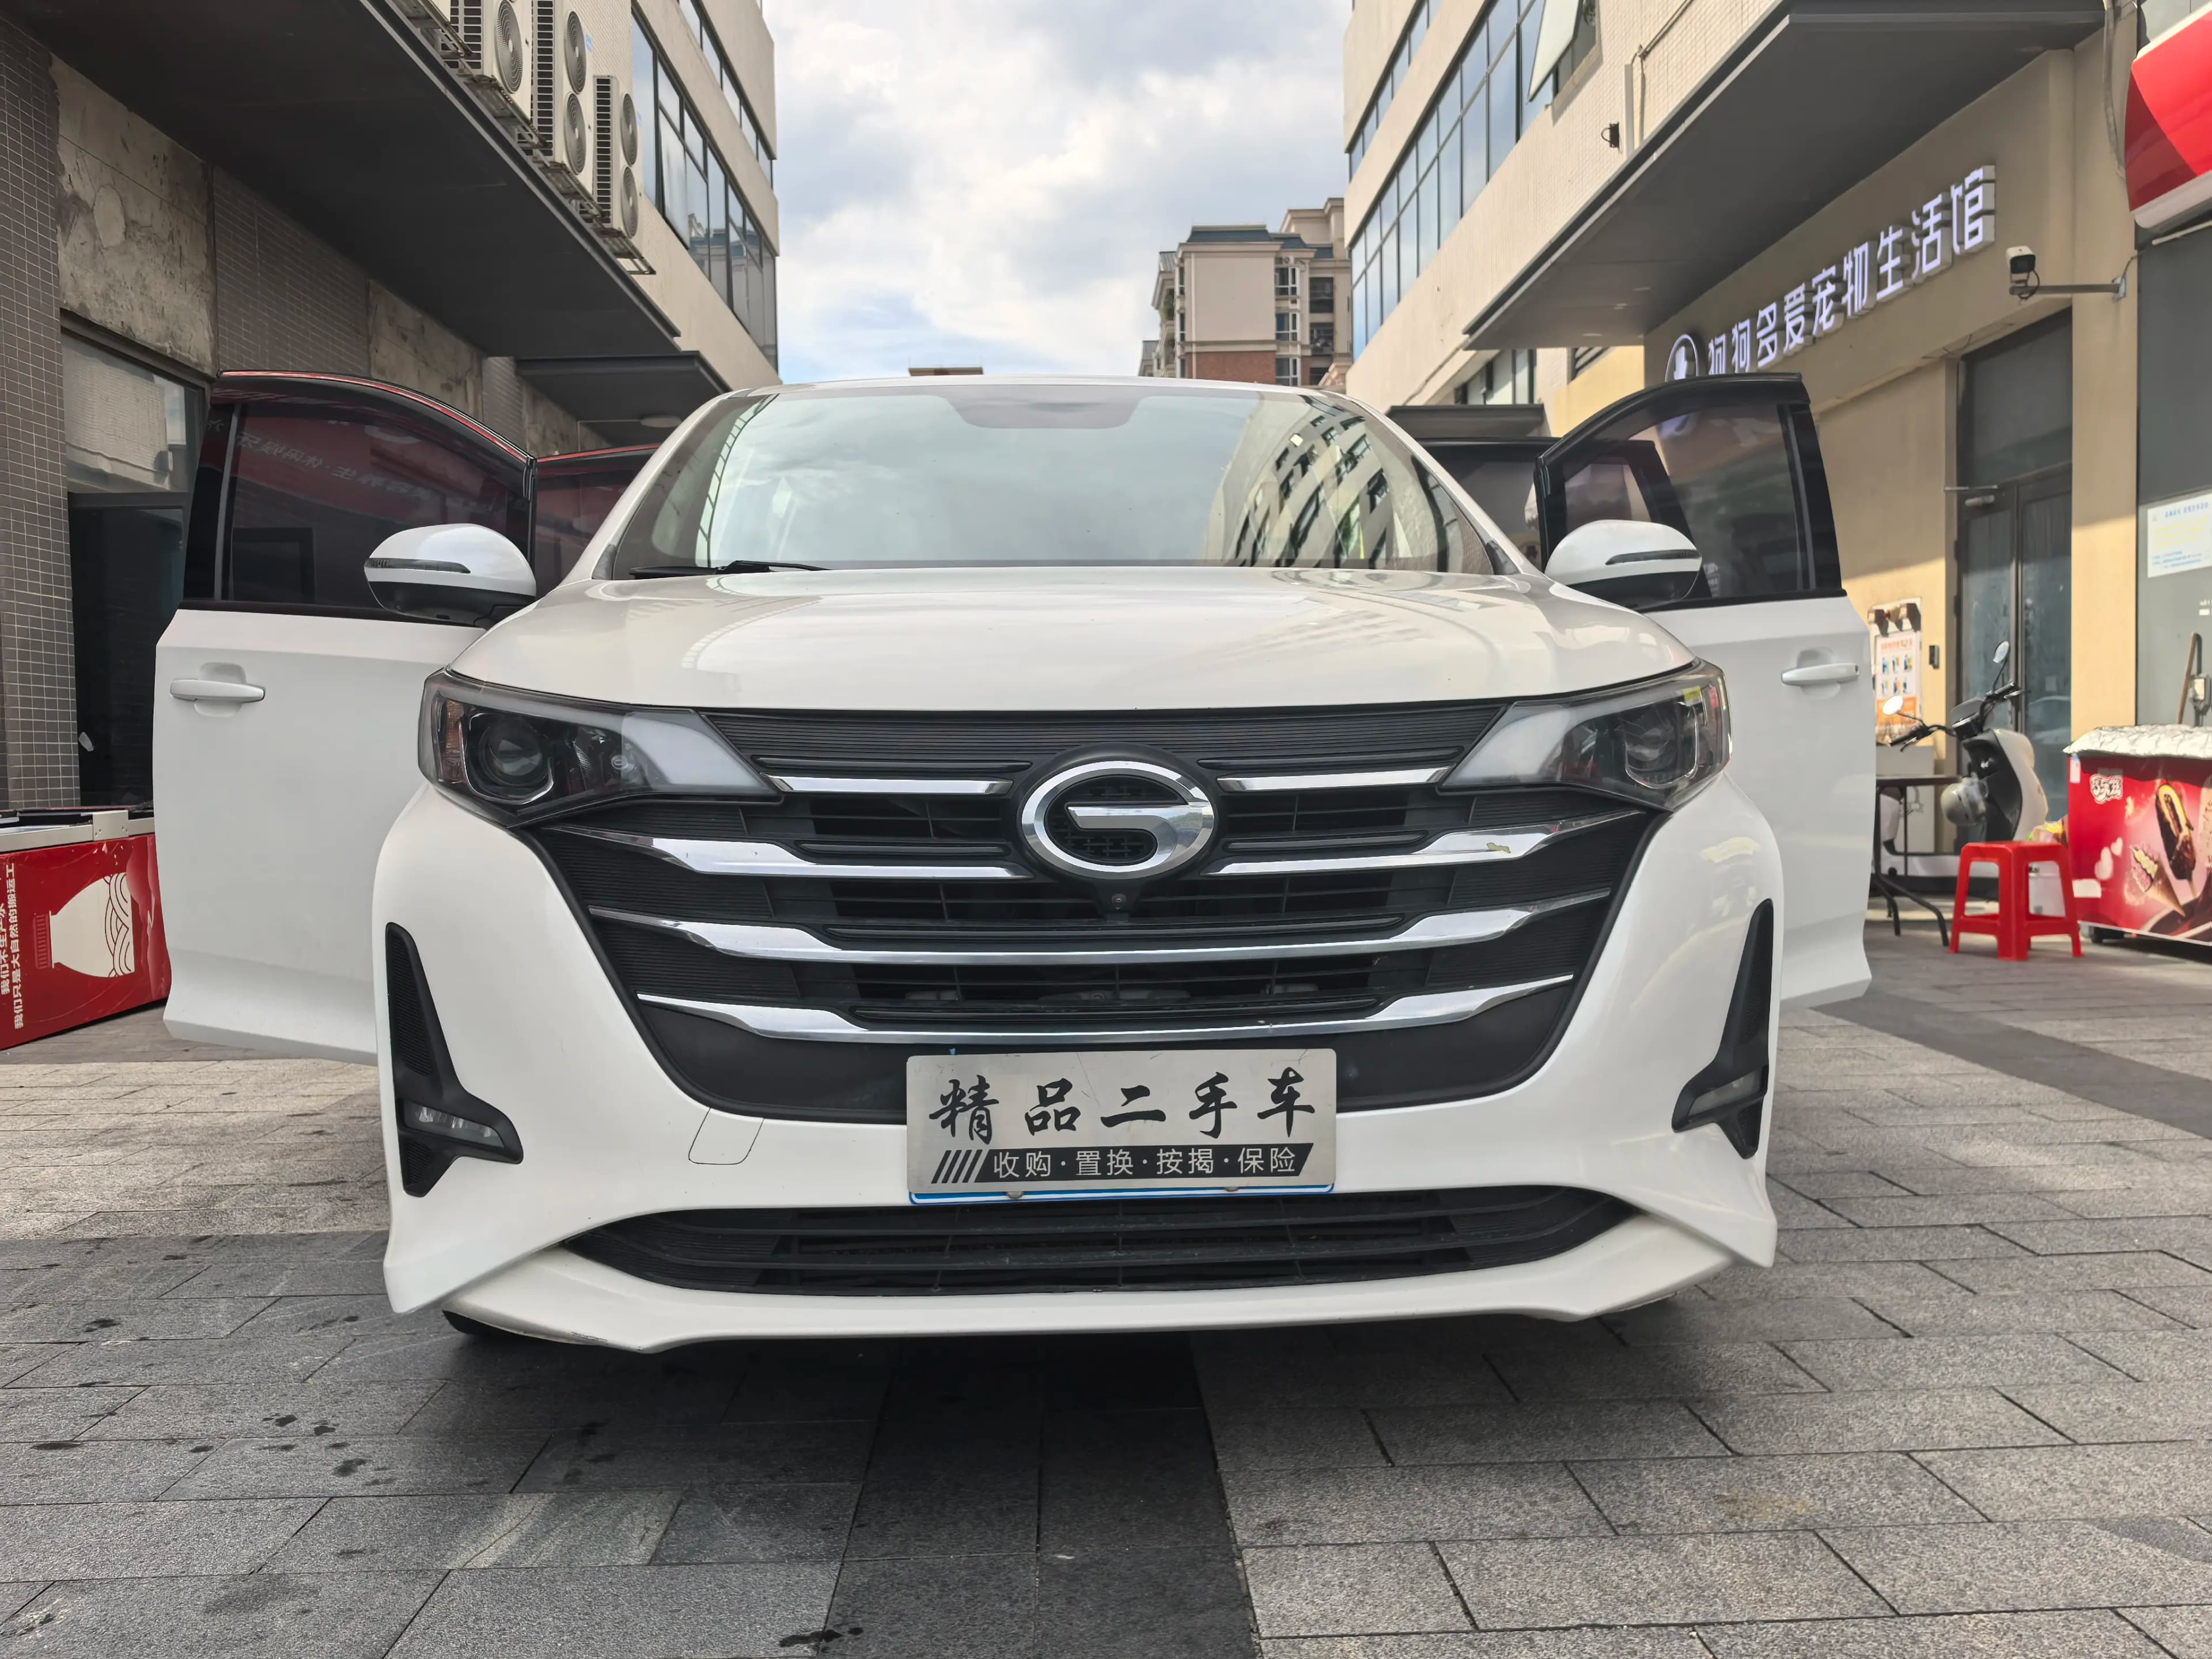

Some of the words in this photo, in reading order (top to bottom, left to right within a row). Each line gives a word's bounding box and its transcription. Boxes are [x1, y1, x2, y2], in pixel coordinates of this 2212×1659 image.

[1709, 167, 1985, 375] 狗狗多爱宠物生活馆
[6, 863, 24, 1029] 我们只是大自然的搬运工
[929, 1066, 1316, 1145] 精品二手车
